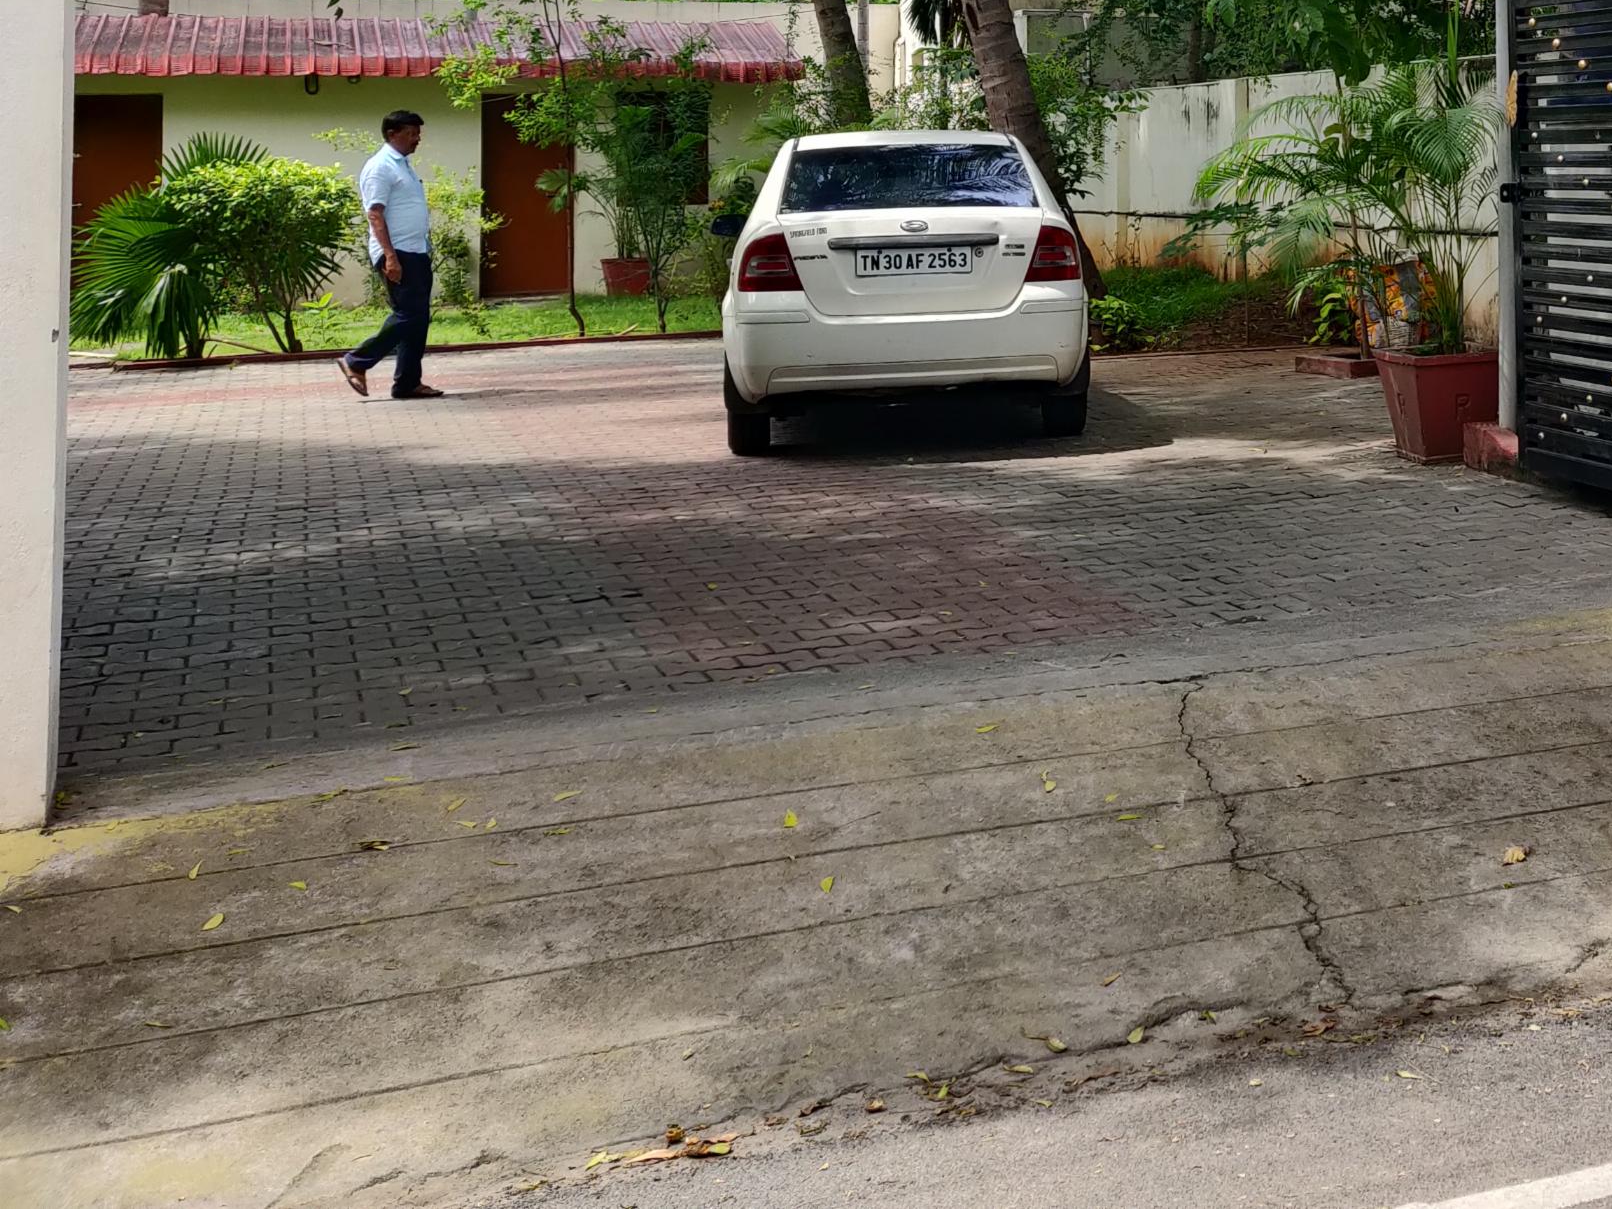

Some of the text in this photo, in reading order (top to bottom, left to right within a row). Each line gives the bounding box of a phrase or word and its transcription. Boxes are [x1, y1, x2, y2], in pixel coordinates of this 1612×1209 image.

[860, 252, 967, 271] TN 30 AF 2563
